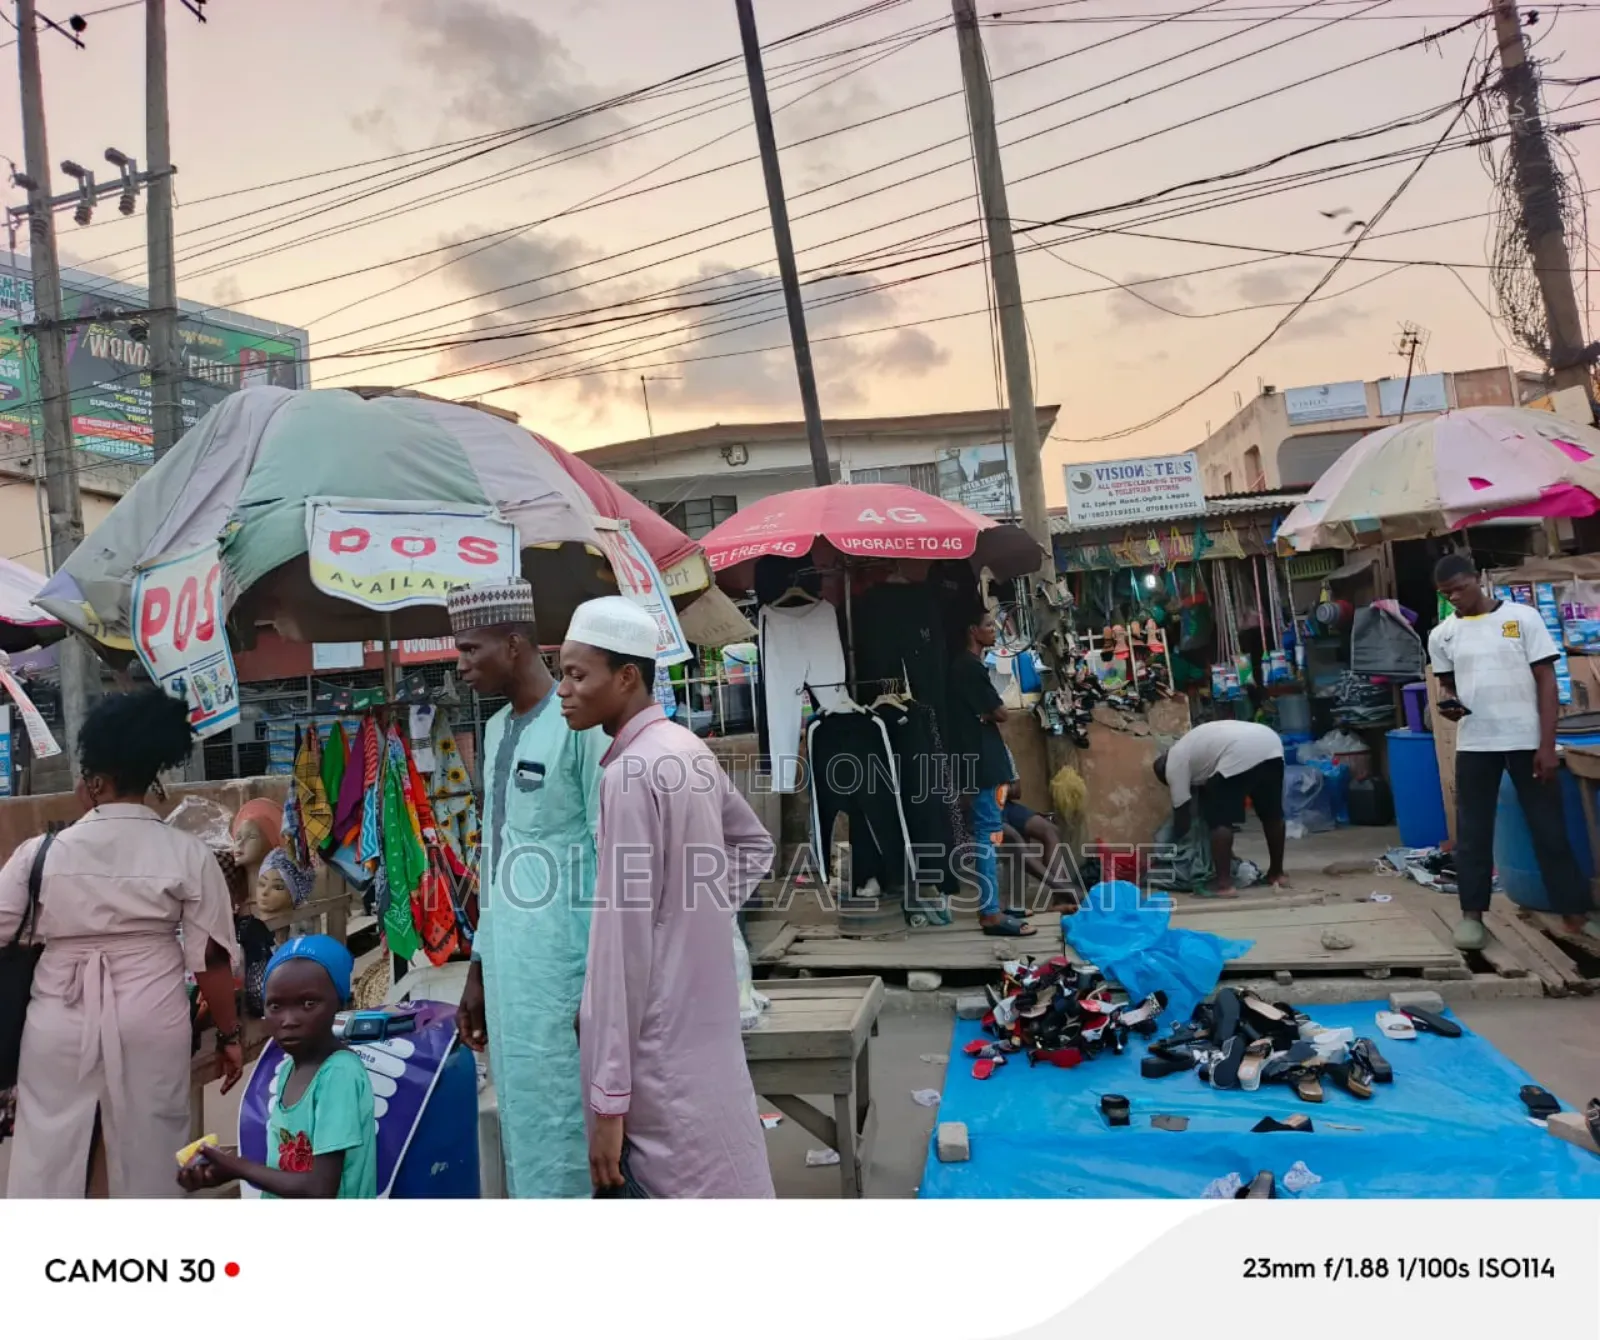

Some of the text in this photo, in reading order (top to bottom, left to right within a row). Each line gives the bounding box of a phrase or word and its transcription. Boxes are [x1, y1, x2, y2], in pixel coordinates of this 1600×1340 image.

[857, 507, 928, 525] 4G
[328, 526, 500, 566] POS
[709, 541, 797, 568] ET FREE 4G
[841, 537, 963, 551] UPGRADE TO 4G
[663, 567, 690, 588] art
[140, 563, 221, 664] POS
